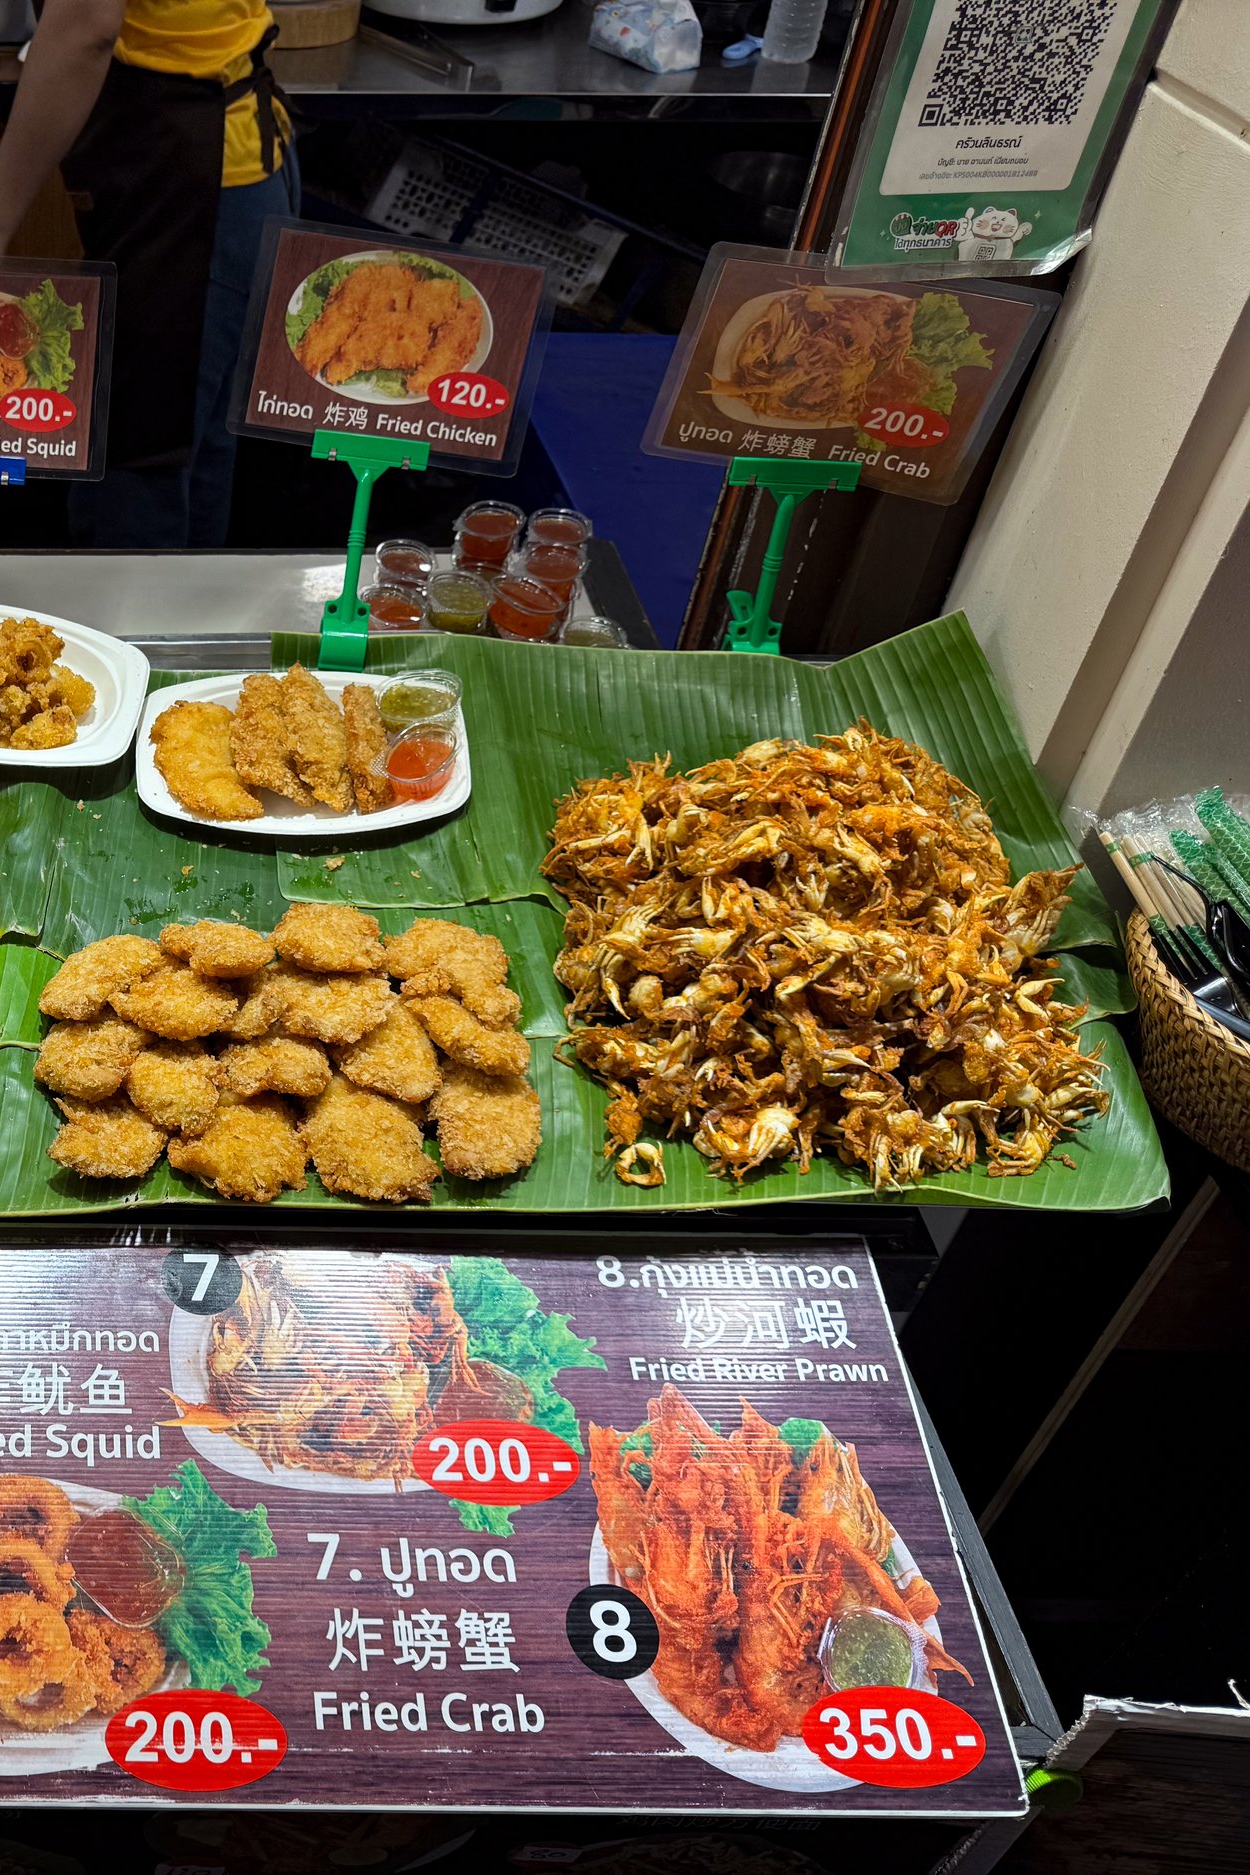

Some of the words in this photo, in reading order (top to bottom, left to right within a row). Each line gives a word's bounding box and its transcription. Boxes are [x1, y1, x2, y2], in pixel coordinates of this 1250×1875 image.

[5, 396, 72, 422] 200.-
[437, 379, 505, 409] 120.-
[257, 390, 314, 420] ไก่ทอด
[322, 401, 369, 430] 炸鸡
[376, 414, 421, 436] Fried
[426, 421, 498, 447] Chicken
[863, 407, 943, 440] 200.-
[26, 438, 76, 458] Squid
[678, 421, 733, 443] ปูทอด
[738, 429, 817, 459] 炸螃蟹
[828, 445, 878, 466] Fried
[883, 455, 930, 479] Crab
[182, 1254, 220, 1302] 7
[676, 1297, 857, 1349] 炒河蝦
[628, 1357, 707, 1382] Fried
[714, 1357, 788, 1382] River
[795, 1358, 889, 1382] Prawn
[45, 1423, 162, 1466] Squid
[429, 1437, 572, 1484] 200.-
[306, 1533, 362, 1582] 7.
[380, 1536, 517, 1598] ปูทอด
[325, 1607, 521, 1673] 炸螃蟹
[589, 1599, 638, 1663] 8
[313, 1690, 428, 1731] Fried
[440, 1692, 546, 1734] Crab
[819, 1707, 977, 1760] 350.-
[124, 1711, 278, 1763] 200.-
